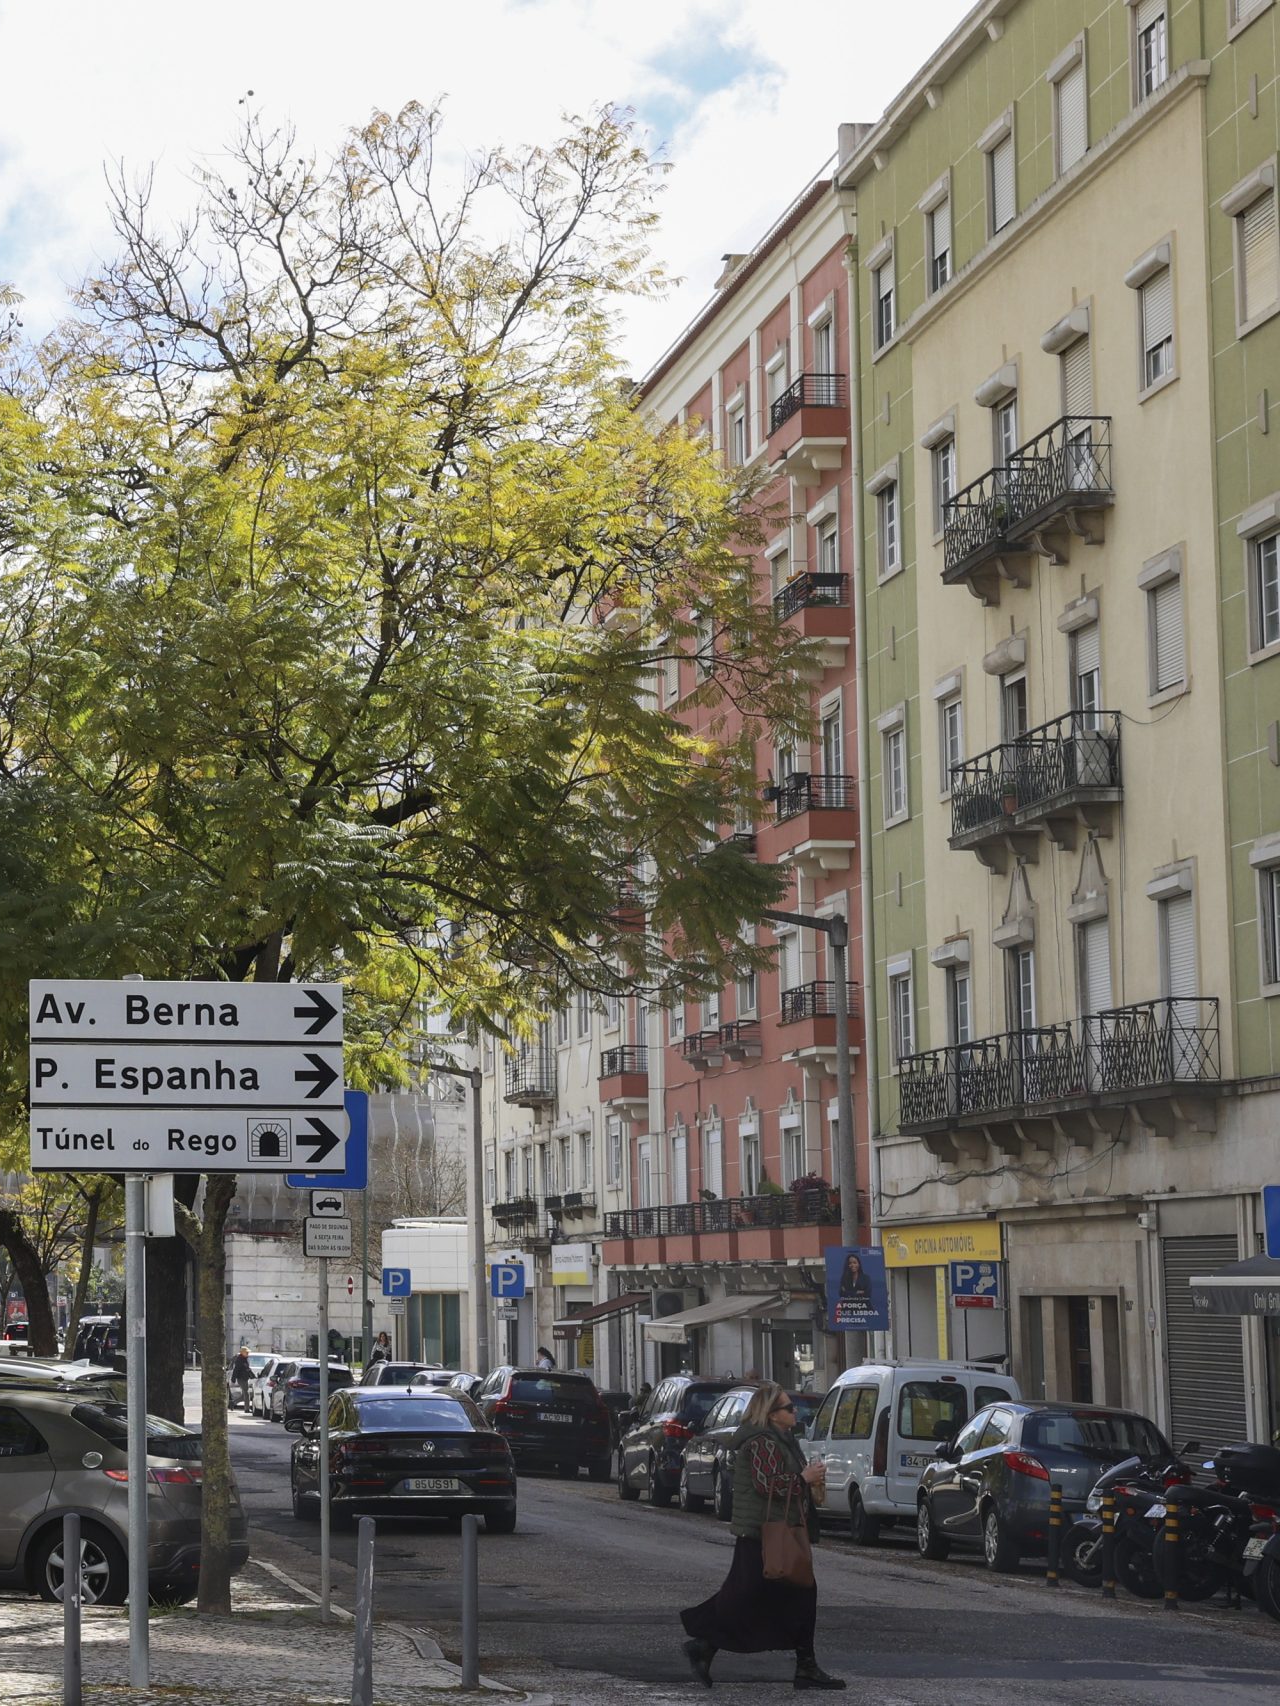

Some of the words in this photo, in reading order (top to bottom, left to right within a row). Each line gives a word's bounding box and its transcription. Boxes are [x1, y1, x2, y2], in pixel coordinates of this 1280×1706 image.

[36, 993, 96, 1025] Av.
[126, 994, 240, 1027] Berna
[35, 1058, 69, 1090] P.
[95, 1058, 260, 1095] Espanha
[37, 1127, 115, 1151] Túnel
[132, 1139, 150, 1151] do
[168, 1128, 237, 1156] Rego
[915, 1238, 938, 1255] OFICINA
[939, 1234, 975, 1253] AUTOMÓVEL
[389, 1271, 404, 1293] P
[498, 1267, 517, 1295] P
[956, 1265, 974, 1287] P
